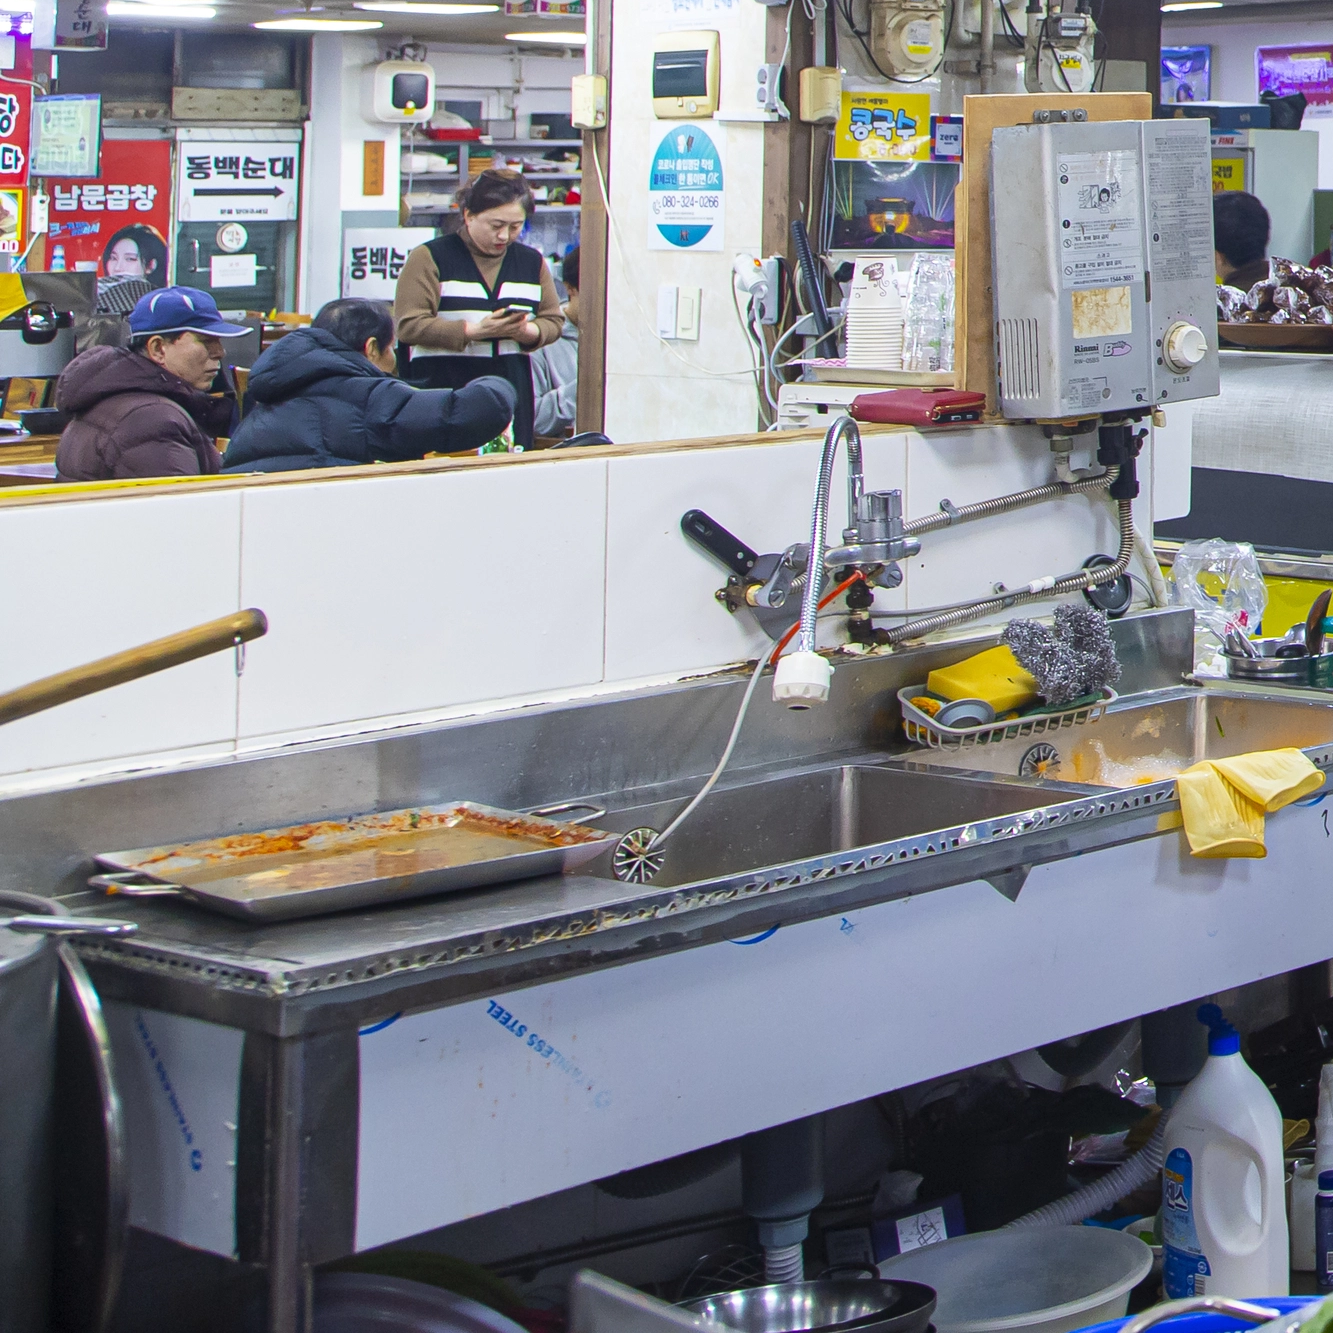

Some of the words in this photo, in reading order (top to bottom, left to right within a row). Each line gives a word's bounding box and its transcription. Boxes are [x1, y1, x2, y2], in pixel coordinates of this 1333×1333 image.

[850, 108, 917, 142] 콩국수
[187, 155, 295, 180] 동백순대
[707, 173, 719, 184] OK
[54, 184, 157, 212] 남문곱창
[662, 196, 719, 208] 080-324-0266
[1074, 343, 1099, 353] Rinnai
[486, 999, 531, 1042] STEEL
